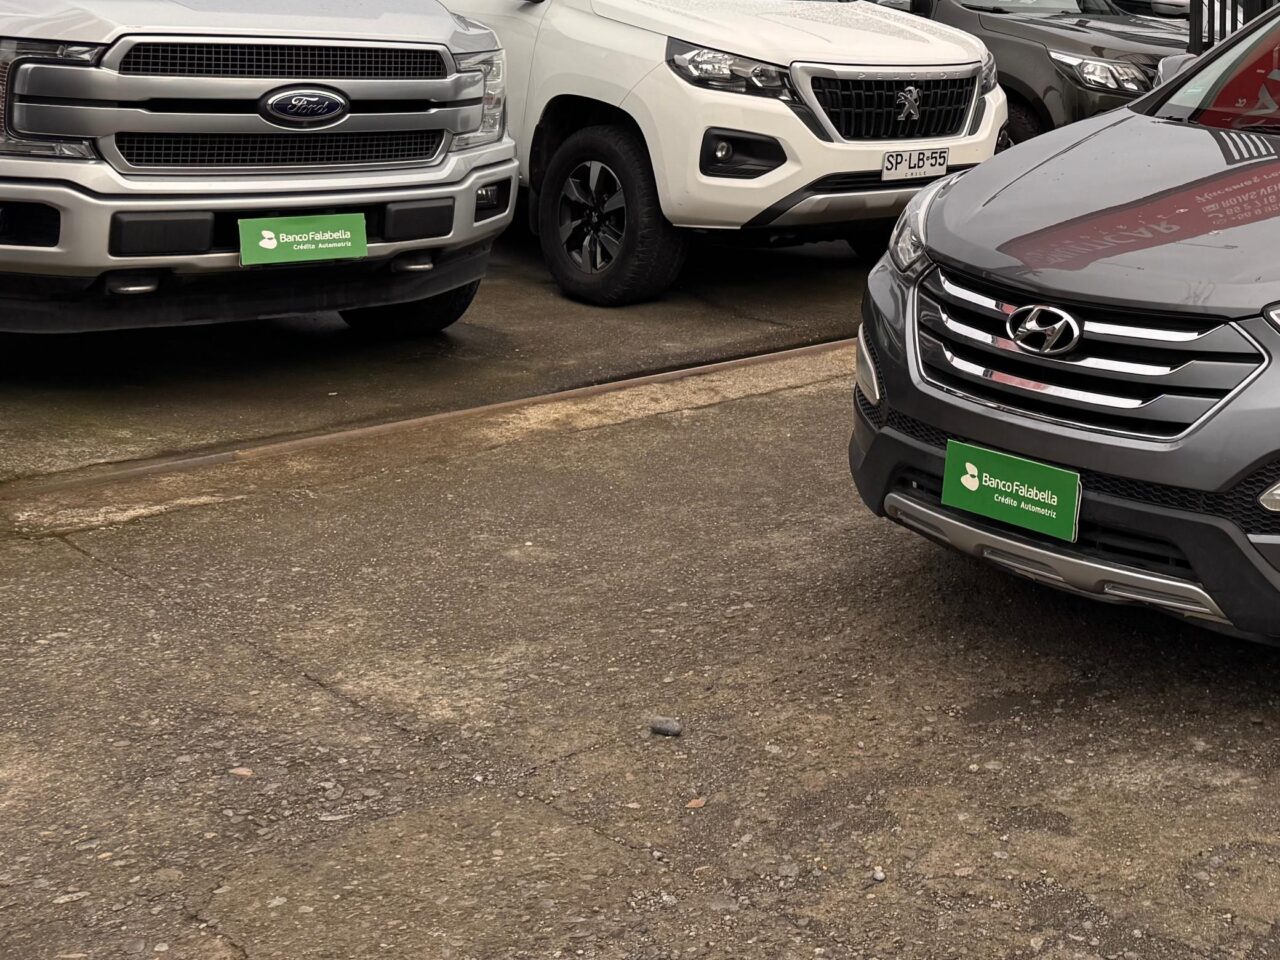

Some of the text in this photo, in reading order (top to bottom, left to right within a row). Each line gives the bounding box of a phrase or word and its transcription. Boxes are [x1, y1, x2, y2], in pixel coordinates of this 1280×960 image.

[287, 96, 329, 113] Ford
[279, 230, 351, 243] Banco Falabella
[982, 473, 1058, 506] Banco Falabella
[994, 494, 1057, 518] Crédito Automotriz
